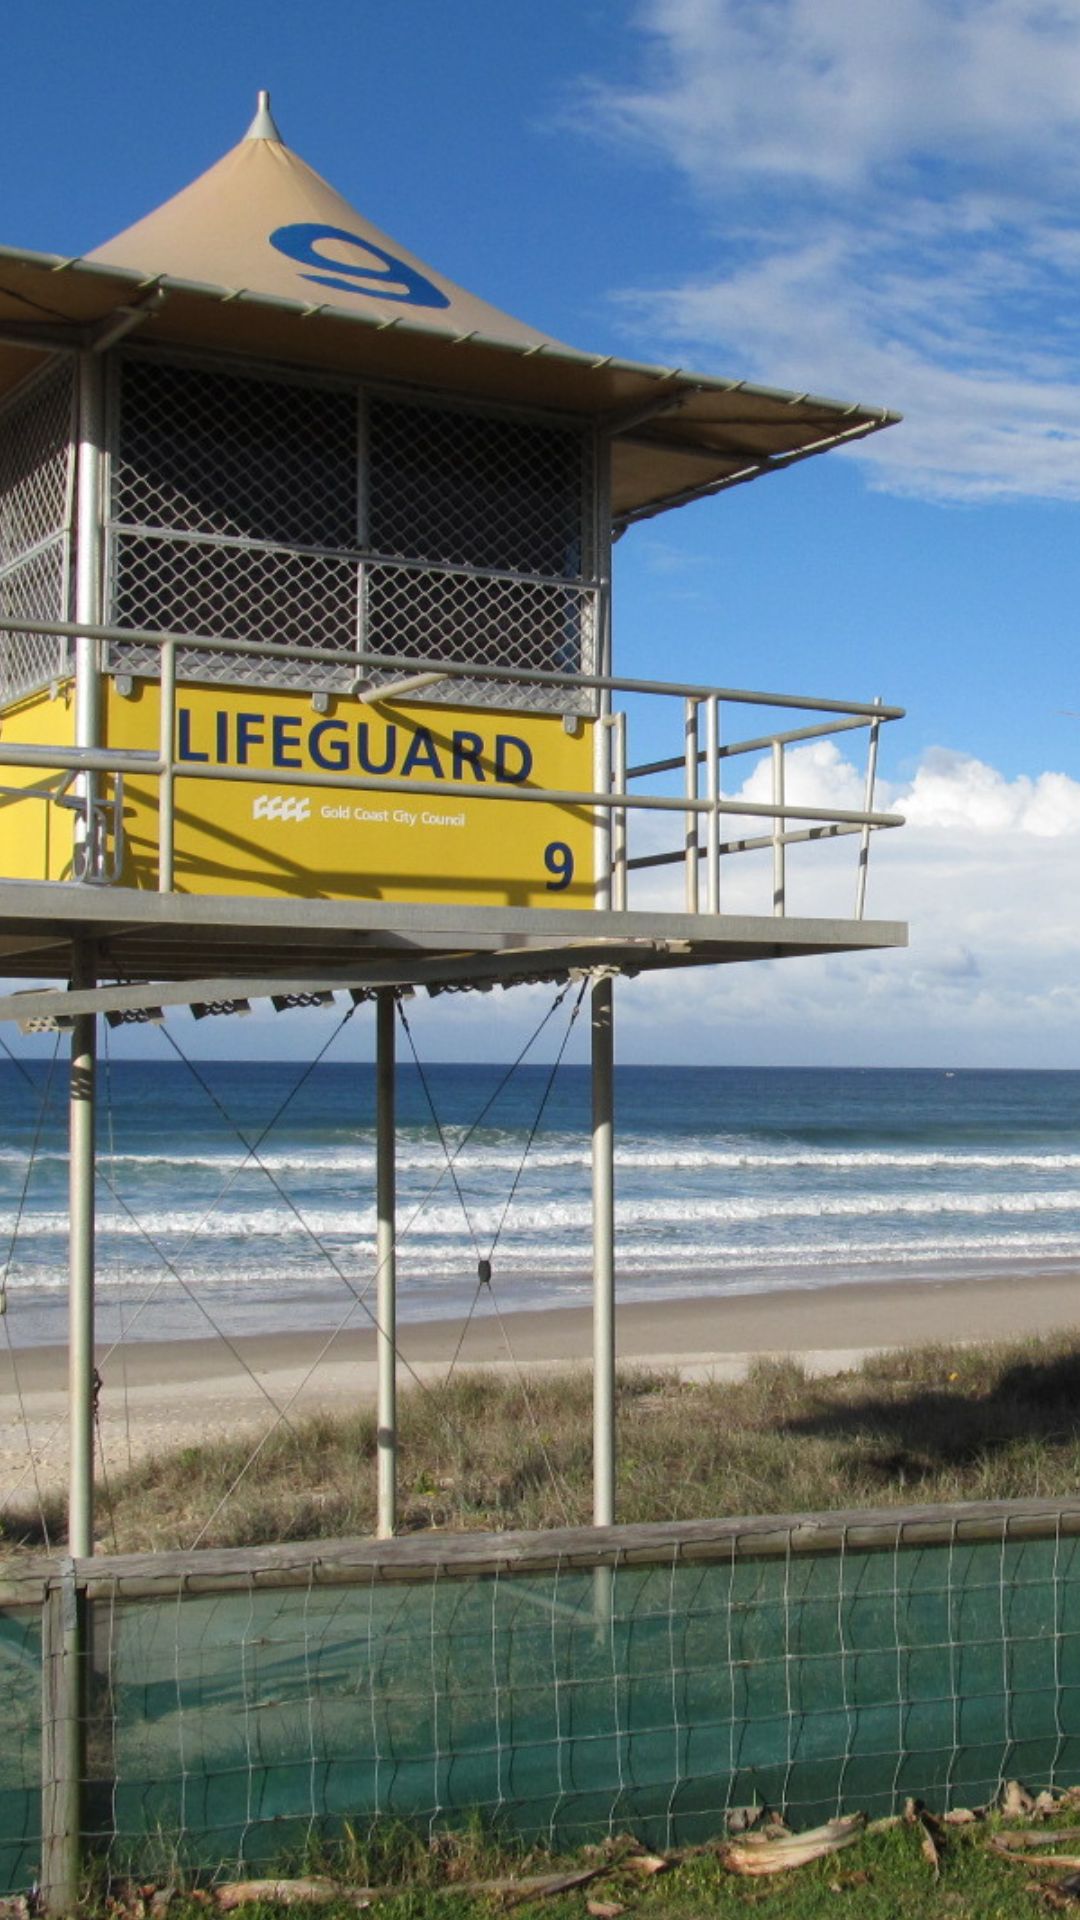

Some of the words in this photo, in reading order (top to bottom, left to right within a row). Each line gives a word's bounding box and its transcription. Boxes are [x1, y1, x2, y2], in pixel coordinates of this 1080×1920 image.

[269, 223, 451, 309] 9
[178, 708, 534, 783] LIFEGUARD
[320, 805, 350, 820] Gold
[353, 808, 389, 823] Coast
[393, 809, 417, 827] City
[421, 811, 466, 827] Council
[544, 842, 574, 891] 9
